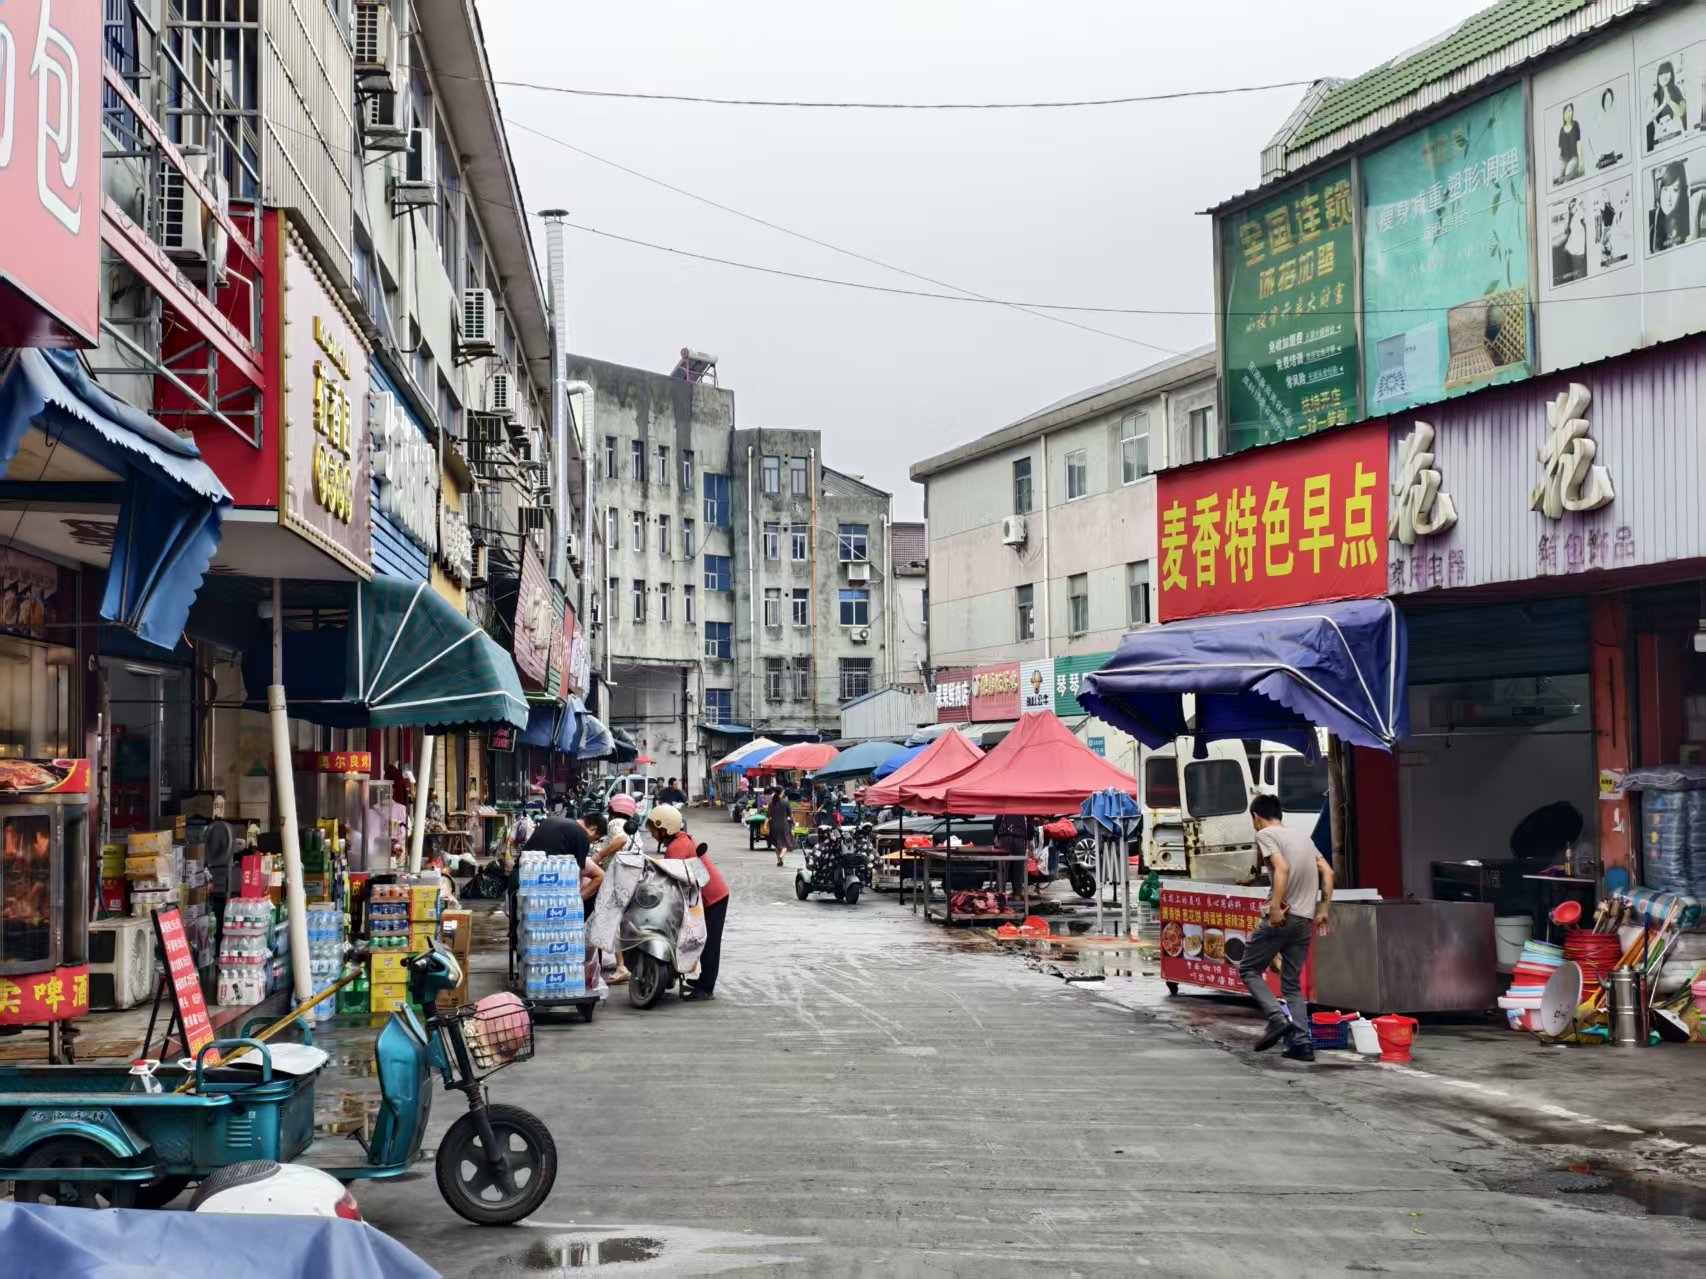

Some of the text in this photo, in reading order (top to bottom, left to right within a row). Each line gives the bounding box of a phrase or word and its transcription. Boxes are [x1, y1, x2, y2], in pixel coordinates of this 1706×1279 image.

[1240, 179, 1354, 267] 全国连锁
[1447, 146, 1521, 203] 塑形调理
[1259, 241, 1335, 300] 诚招加盟
[1388, 420, 1459, 546] 花
[1530, 383, 1616, 520] 花
[1161, 462, 1378, 592] 麦香特色早点
